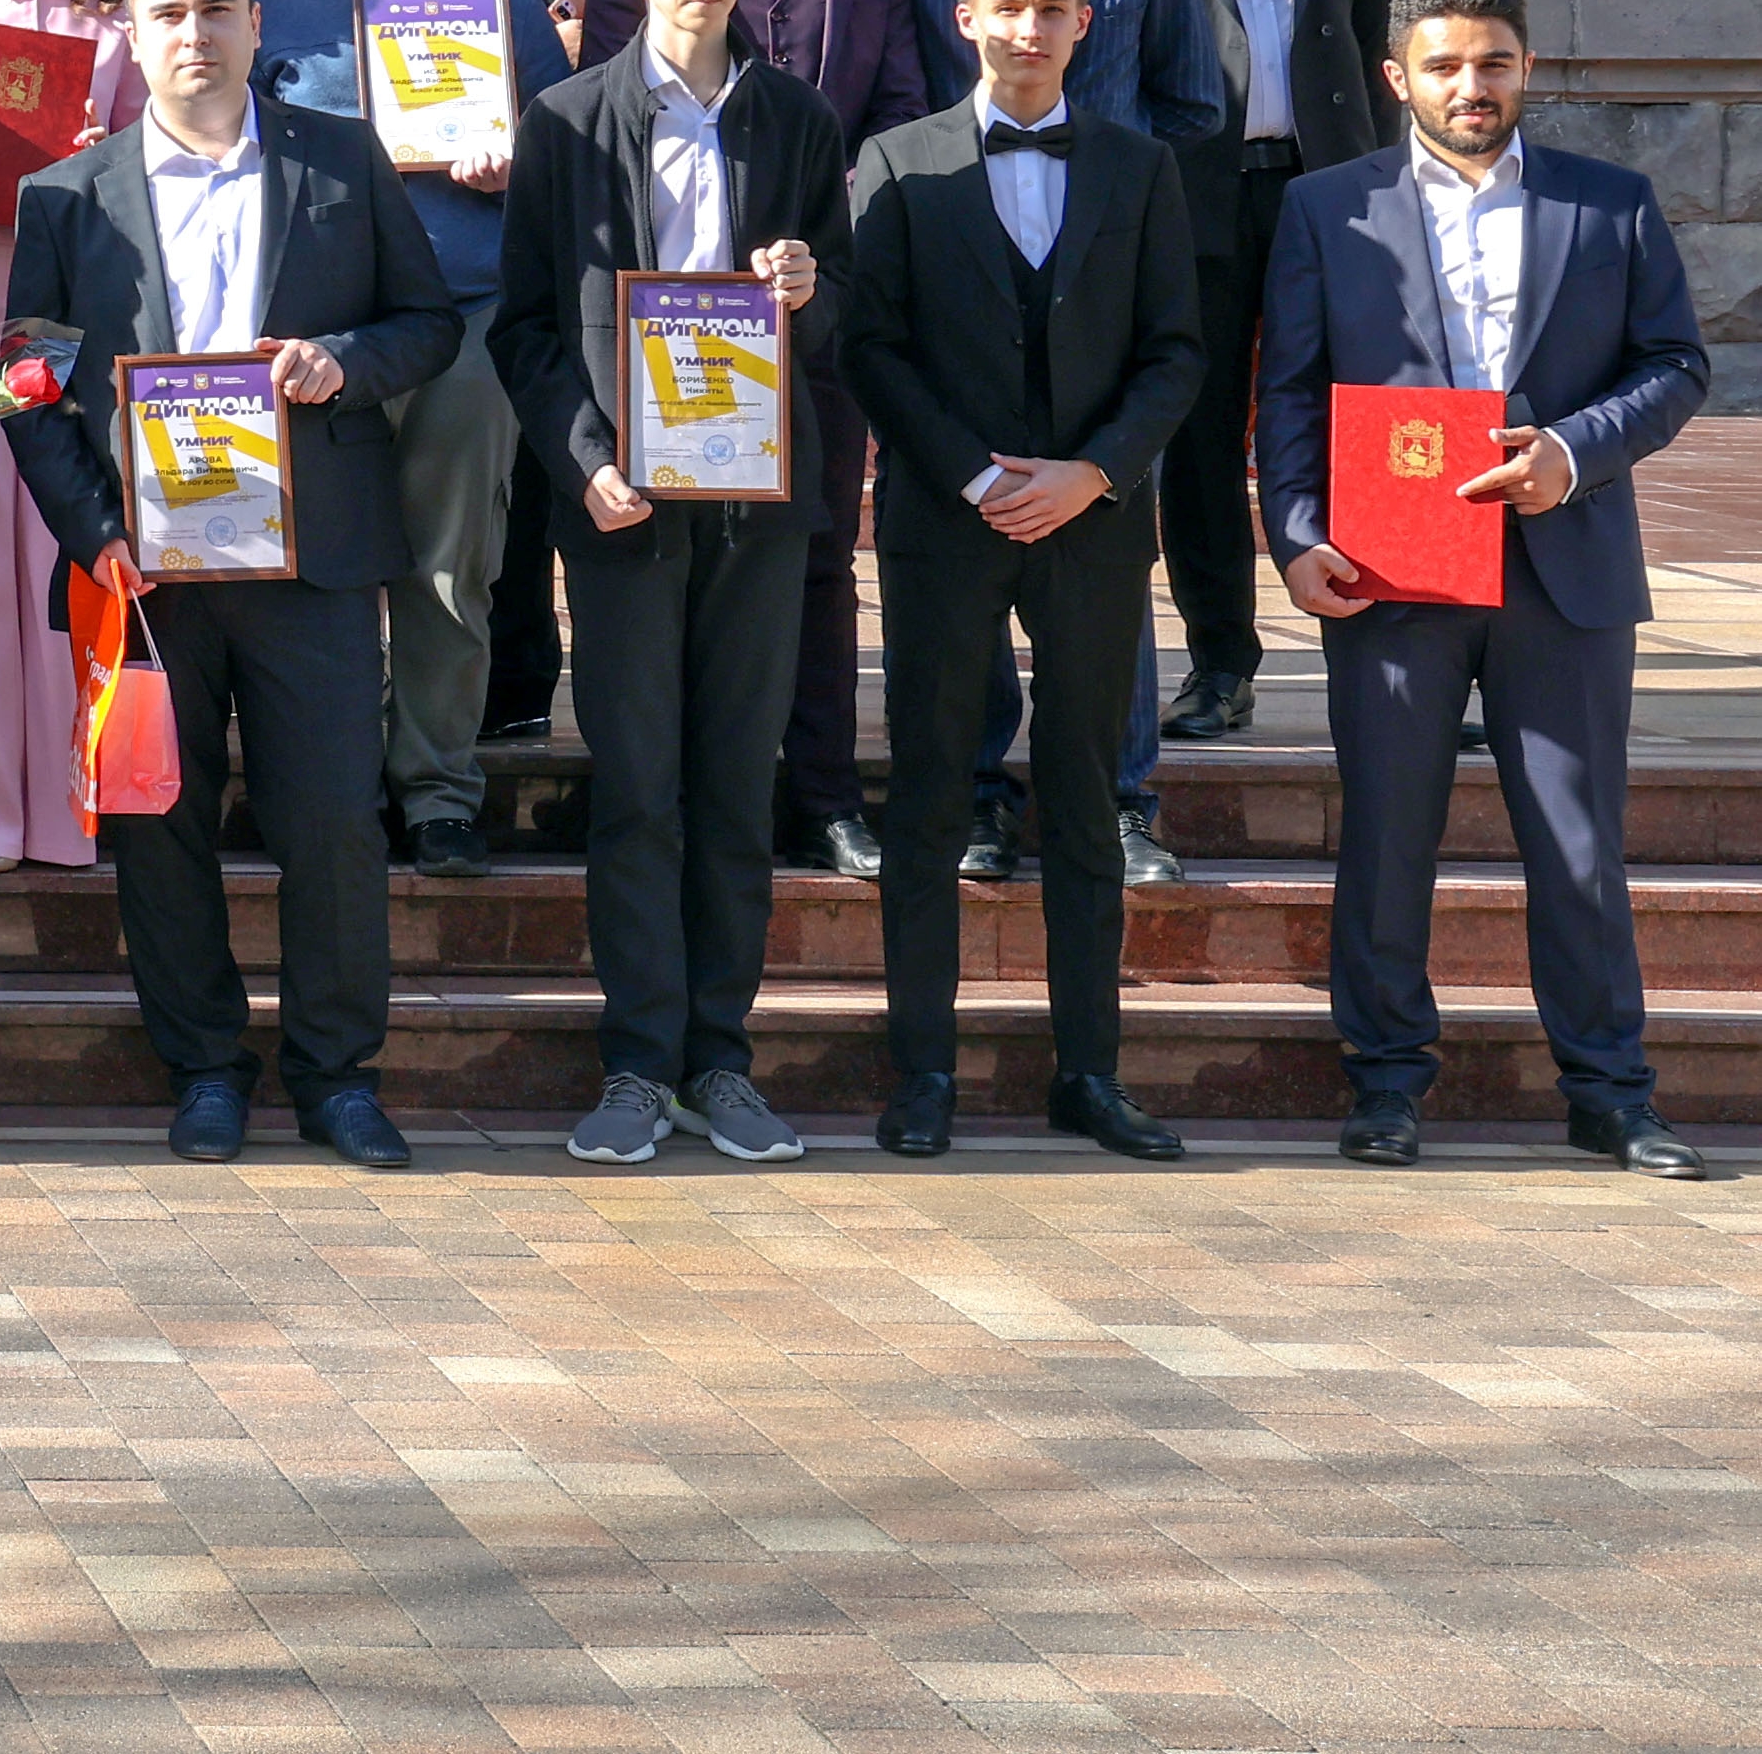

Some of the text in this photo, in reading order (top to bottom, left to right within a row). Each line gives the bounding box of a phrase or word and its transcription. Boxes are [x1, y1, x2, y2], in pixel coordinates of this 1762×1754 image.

[378, 20, 489, 40] ДИПЛОМ
[407, 51, 463, 62] УМНИК
[645, 318, 766, 338] ДИПЛОМ
[674, 357, 735, 367] УМНИК
[672, 376, 735, 384] БОРИСЕНКО
[685, 387, 724, 395] Никиты
[143, 395, 263, 421] ДИПЛОМ
[174, 435, 235, 447] УМНИК
[188, 456, 223, 464] АРОВА
